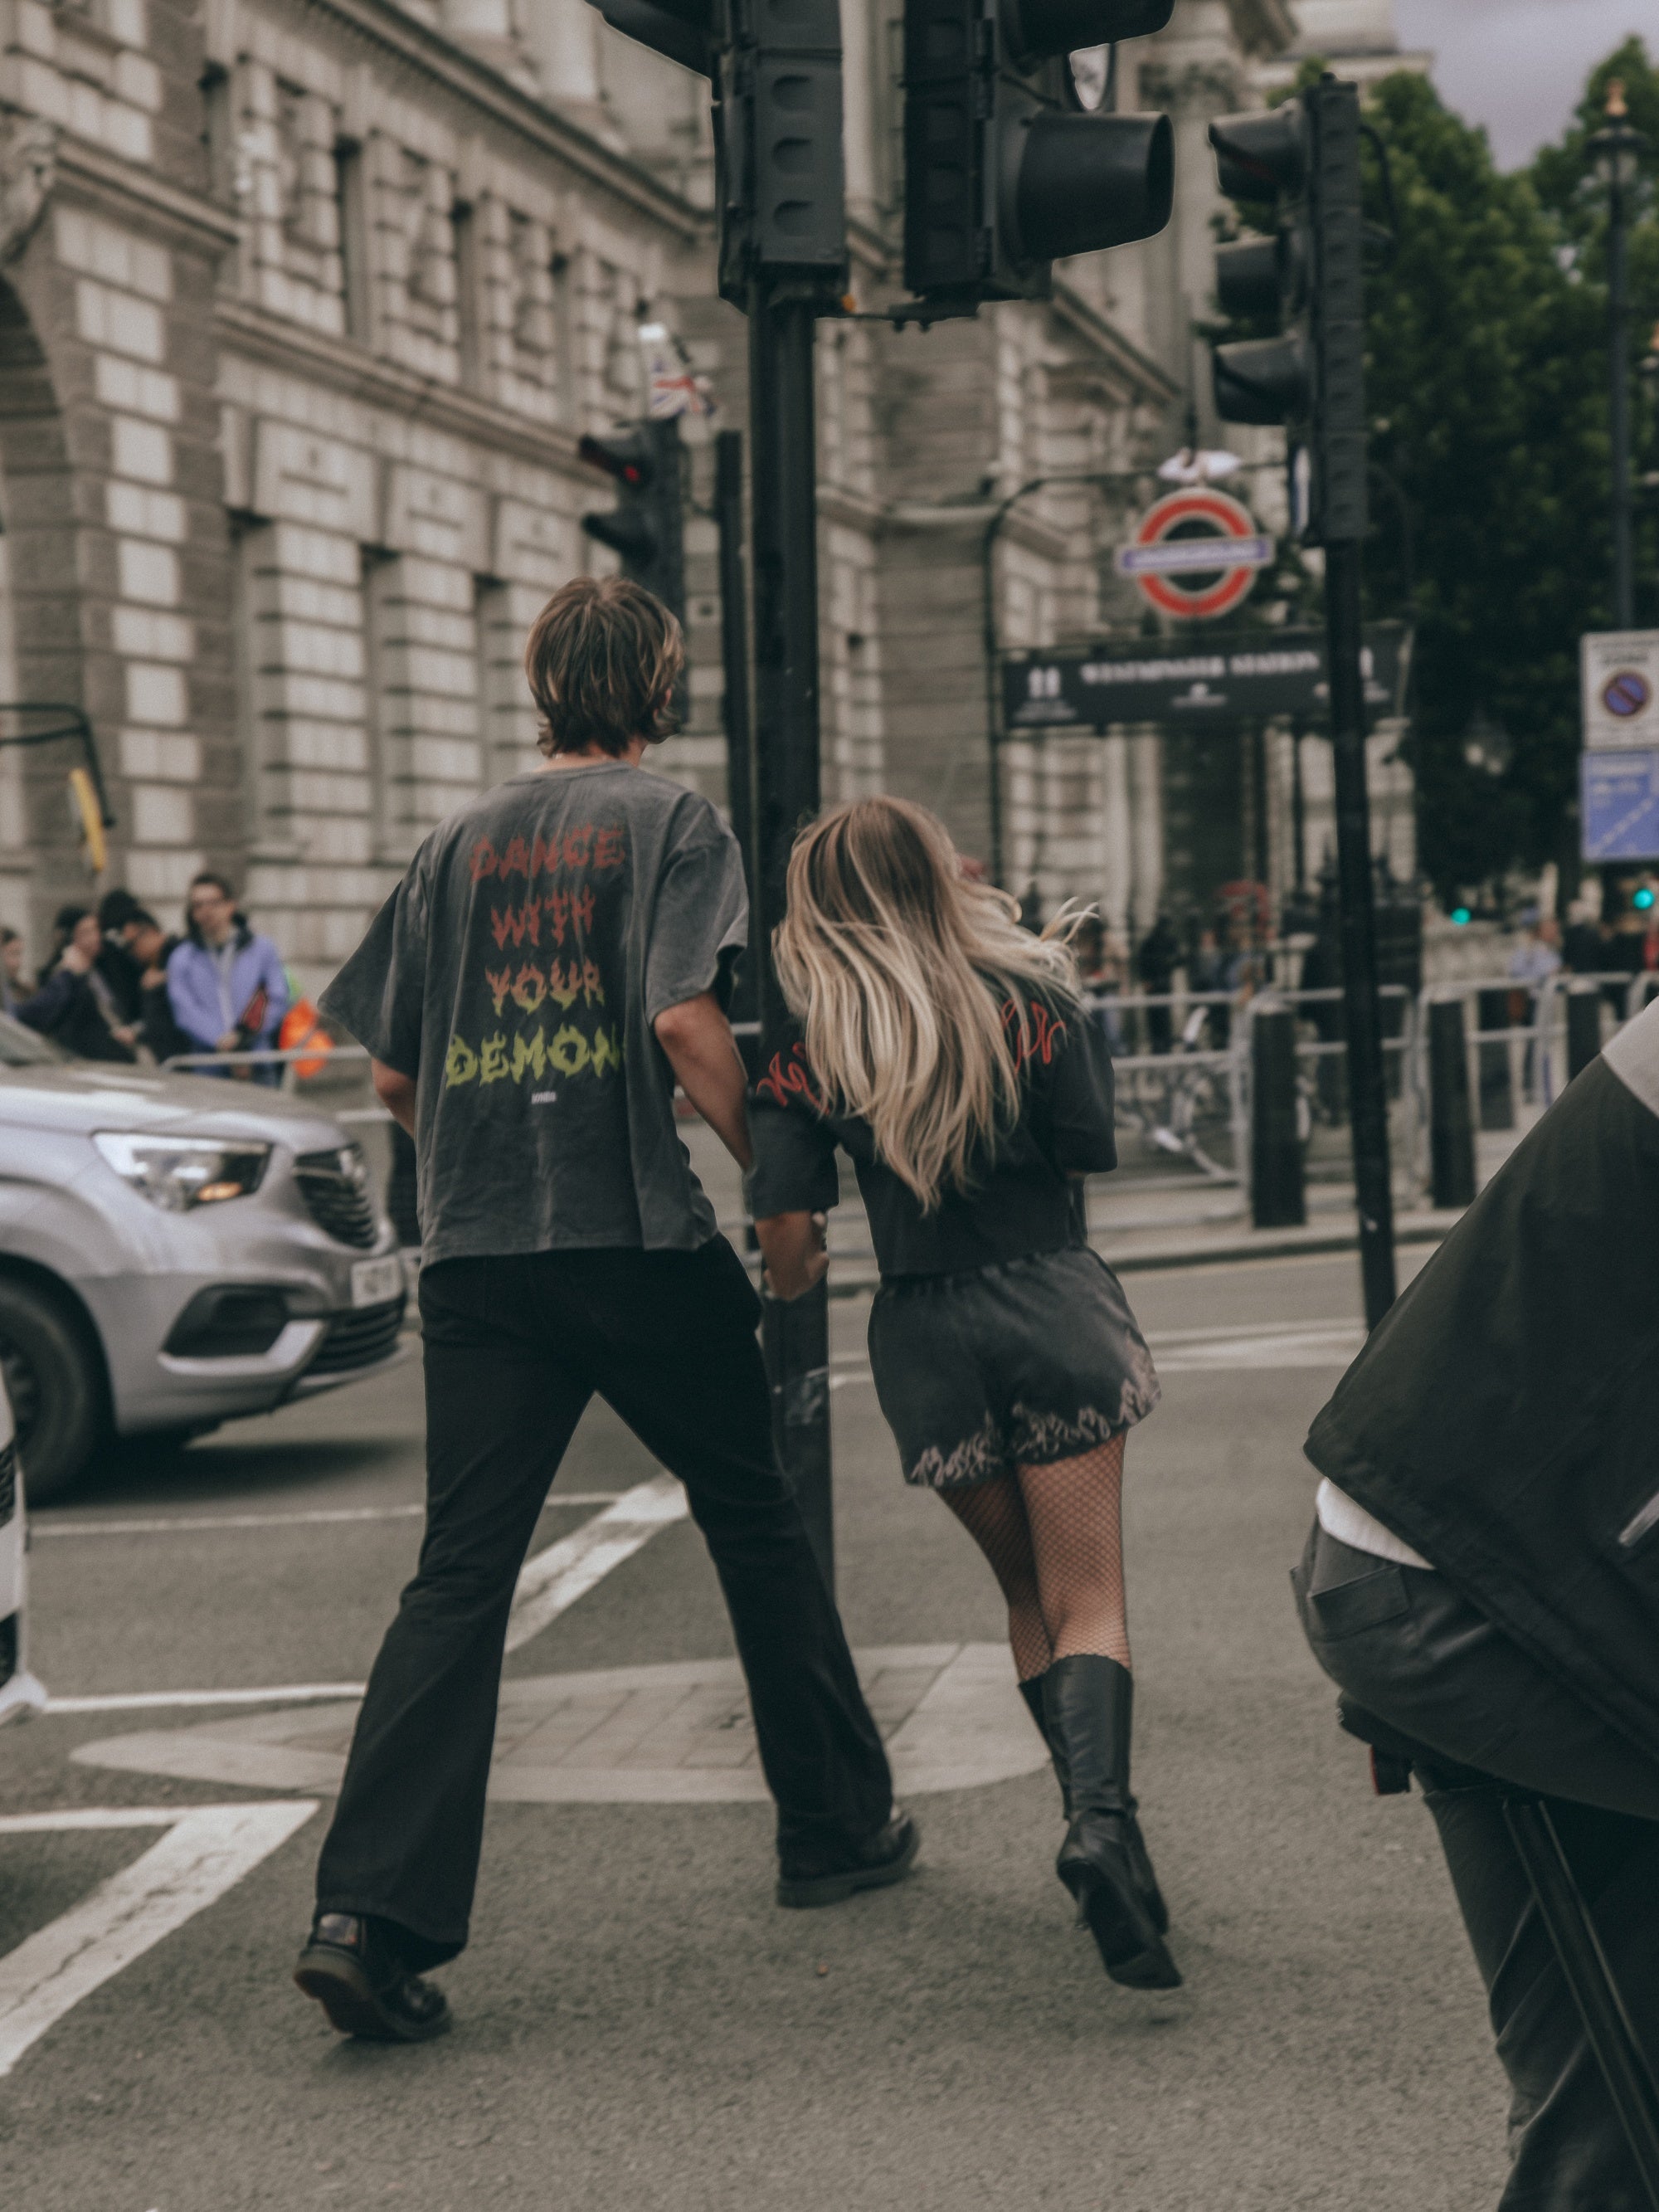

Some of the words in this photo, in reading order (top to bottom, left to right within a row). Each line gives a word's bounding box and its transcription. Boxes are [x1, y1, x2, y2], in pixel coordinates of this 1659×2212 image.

[469, 824, 626, 885] DANCE
[491, 884, 596, 951] WITH
[485, 956, 605, 1017] YOUR
